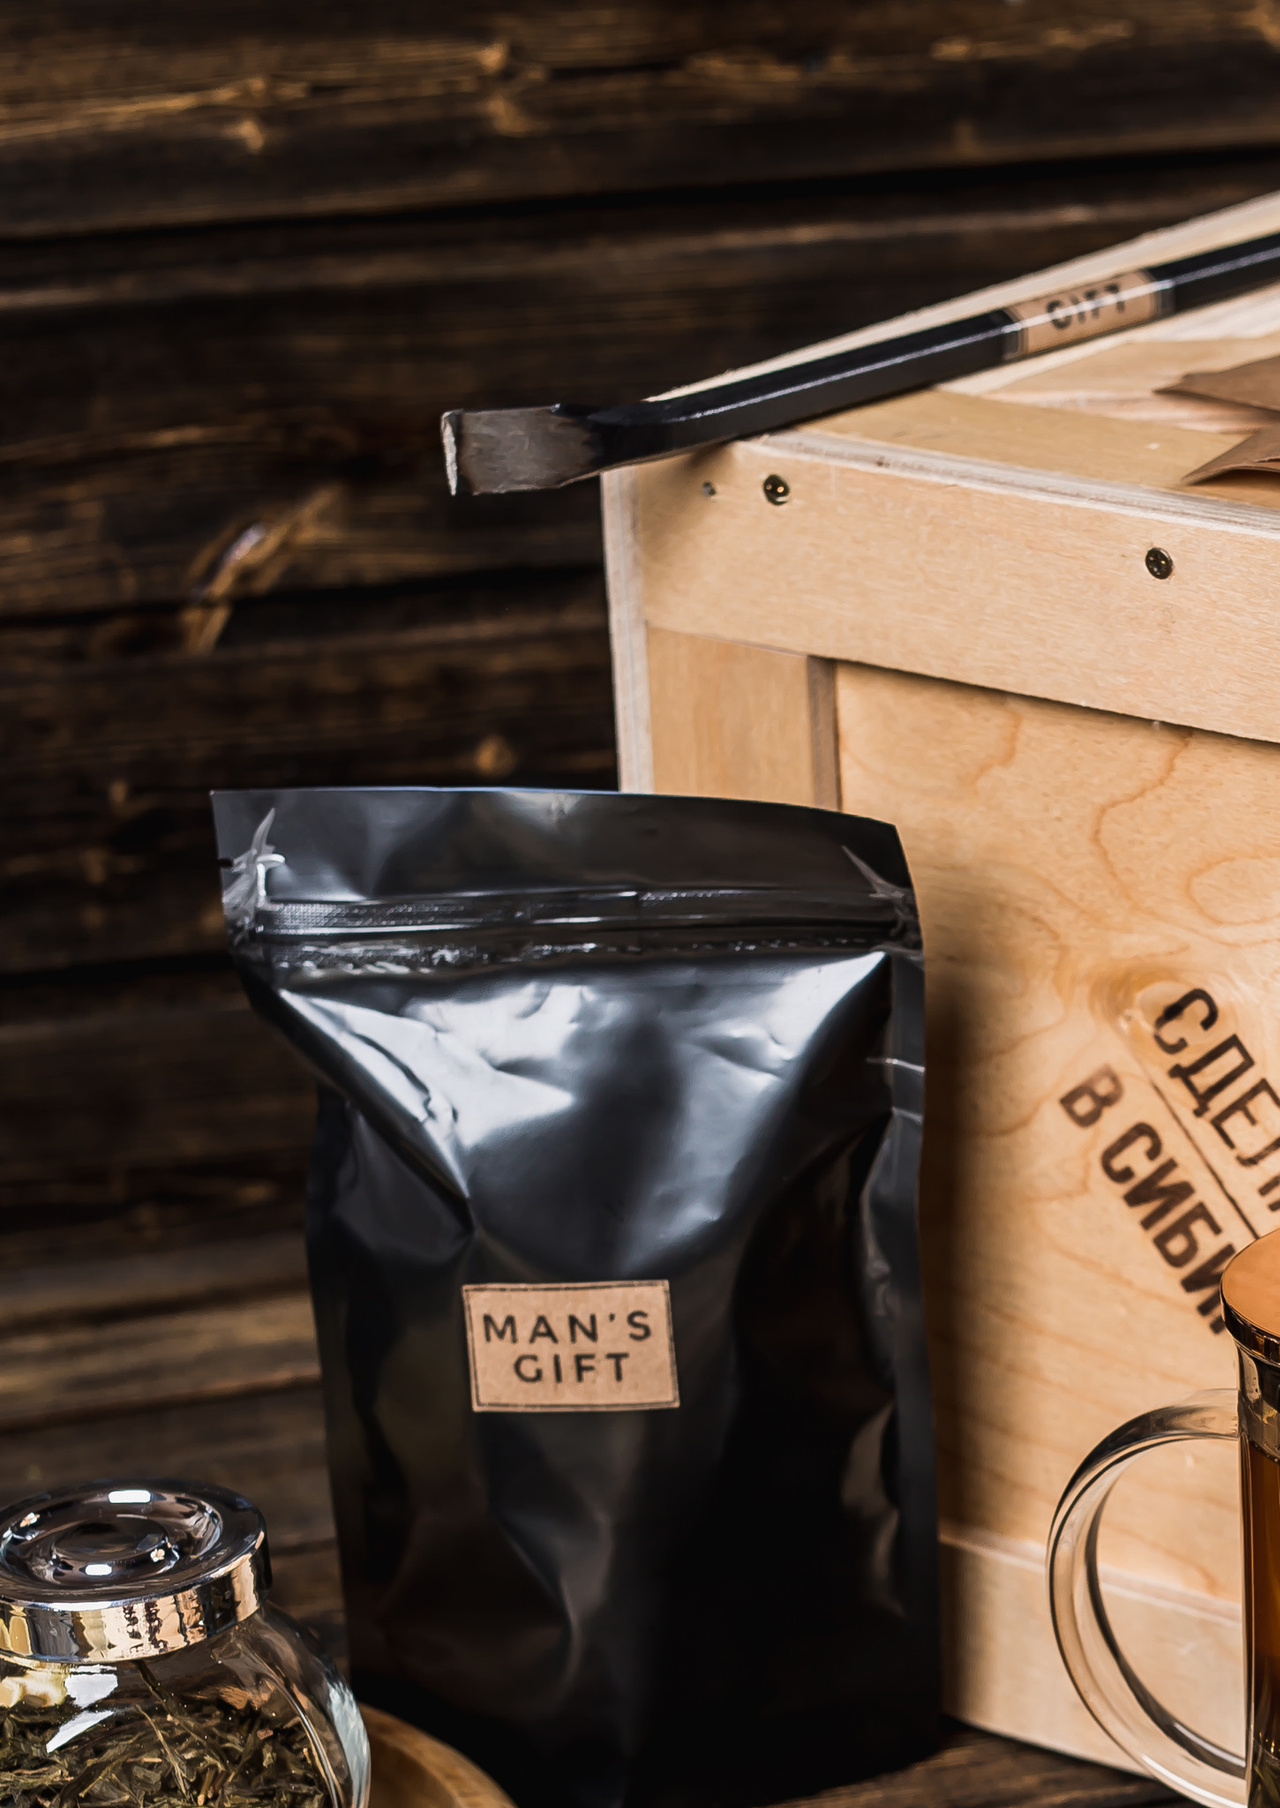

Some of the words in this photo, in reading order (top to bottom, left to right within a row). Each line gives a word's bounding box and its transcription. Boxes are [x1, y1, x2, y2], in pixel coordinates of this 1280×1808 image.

[1059, 1063, 1124, 1129] В
[1100, 1122, 1237, 1335] СИБИ
[483, 1310, 652, 1344] MAN'S
[514, 1352, 629, 1384] GIFT
